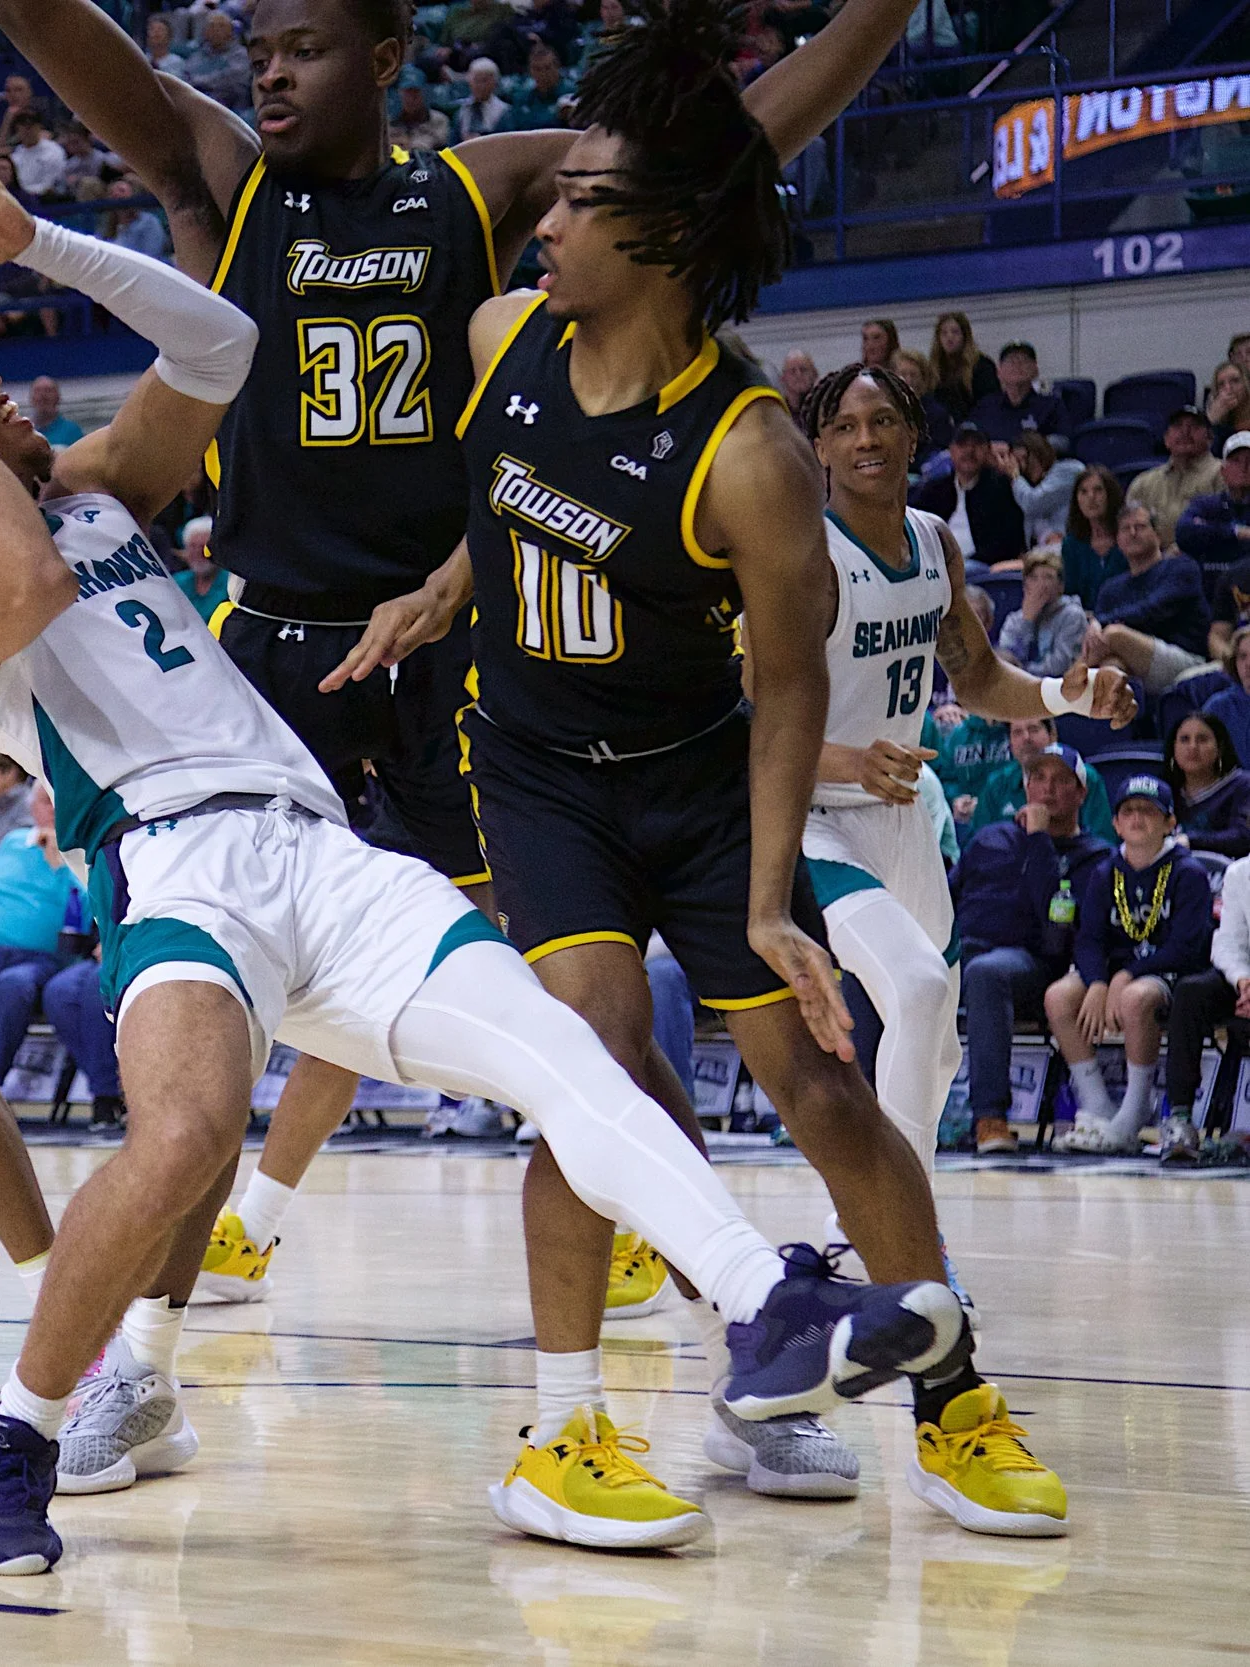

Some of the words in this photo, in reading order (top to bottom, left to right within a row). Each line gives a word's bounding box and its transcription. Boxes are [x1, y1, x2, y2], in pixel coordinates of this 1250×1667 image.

[393, 197, 428, 213] CAA
[289, 240, 431, 293] TOWSON
[1093, 231, 1184, 278] 102
[299, 315, 432, 444] 32
[610, 455, 647, 480] CAA
[490, 454, 631, 560] TOWSON
[75, 533, 168, 602] HAWKS
[512, 530, 622, 662] 10
[926, 568, 940, 581] CAA
[115, 599, 196, 673] 2
[886, 655, 925, 718] 13
